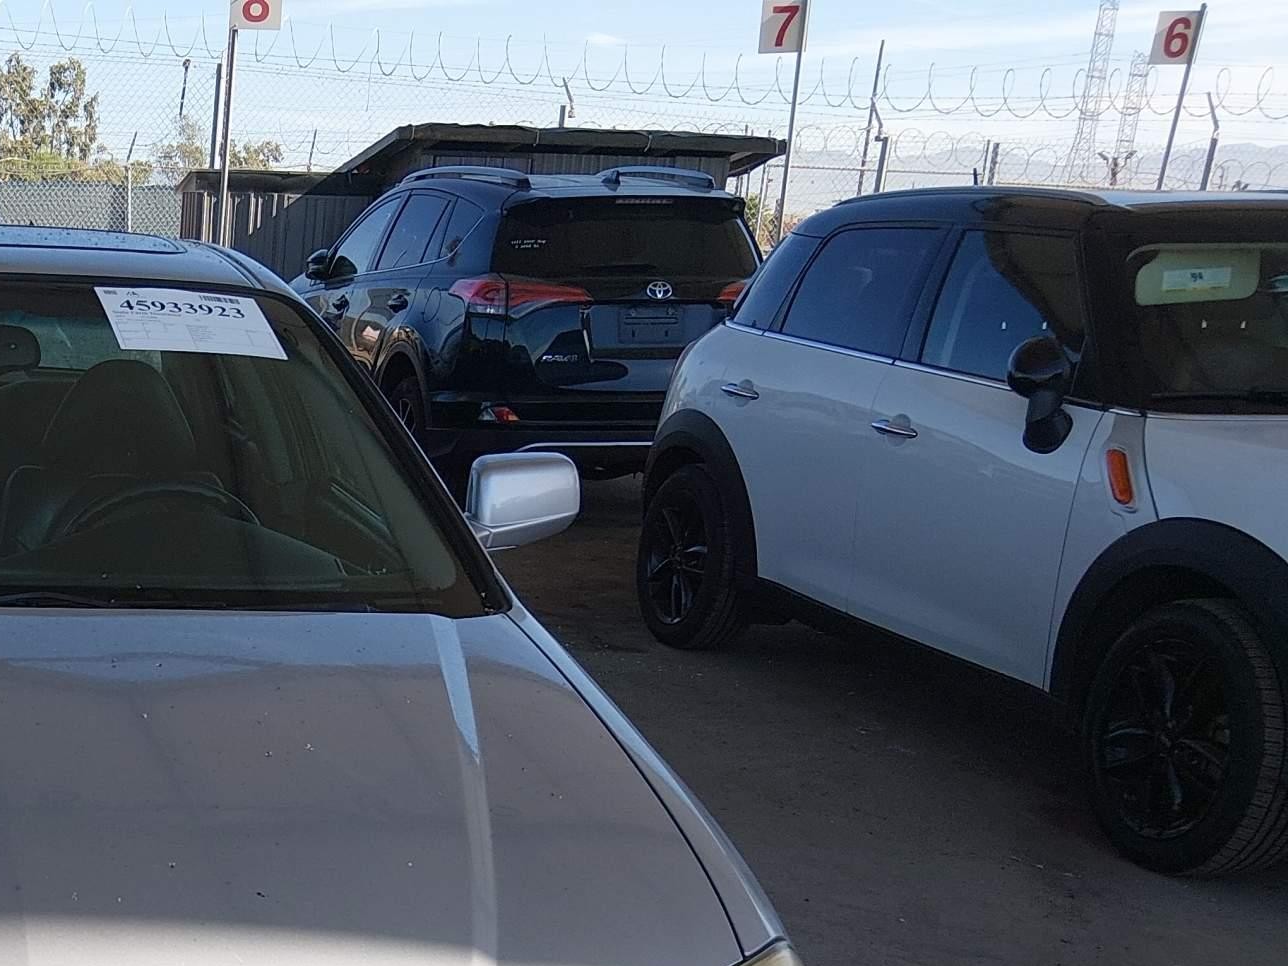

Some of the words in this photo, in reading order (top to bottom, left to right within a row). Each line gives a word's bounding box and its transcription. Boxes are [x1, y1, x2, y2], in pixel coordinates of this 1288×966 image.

[773, 5, 800, 47] 7
[1164, 17, 1191, 58] 6
[120, 299, 245, 319] 45933923
